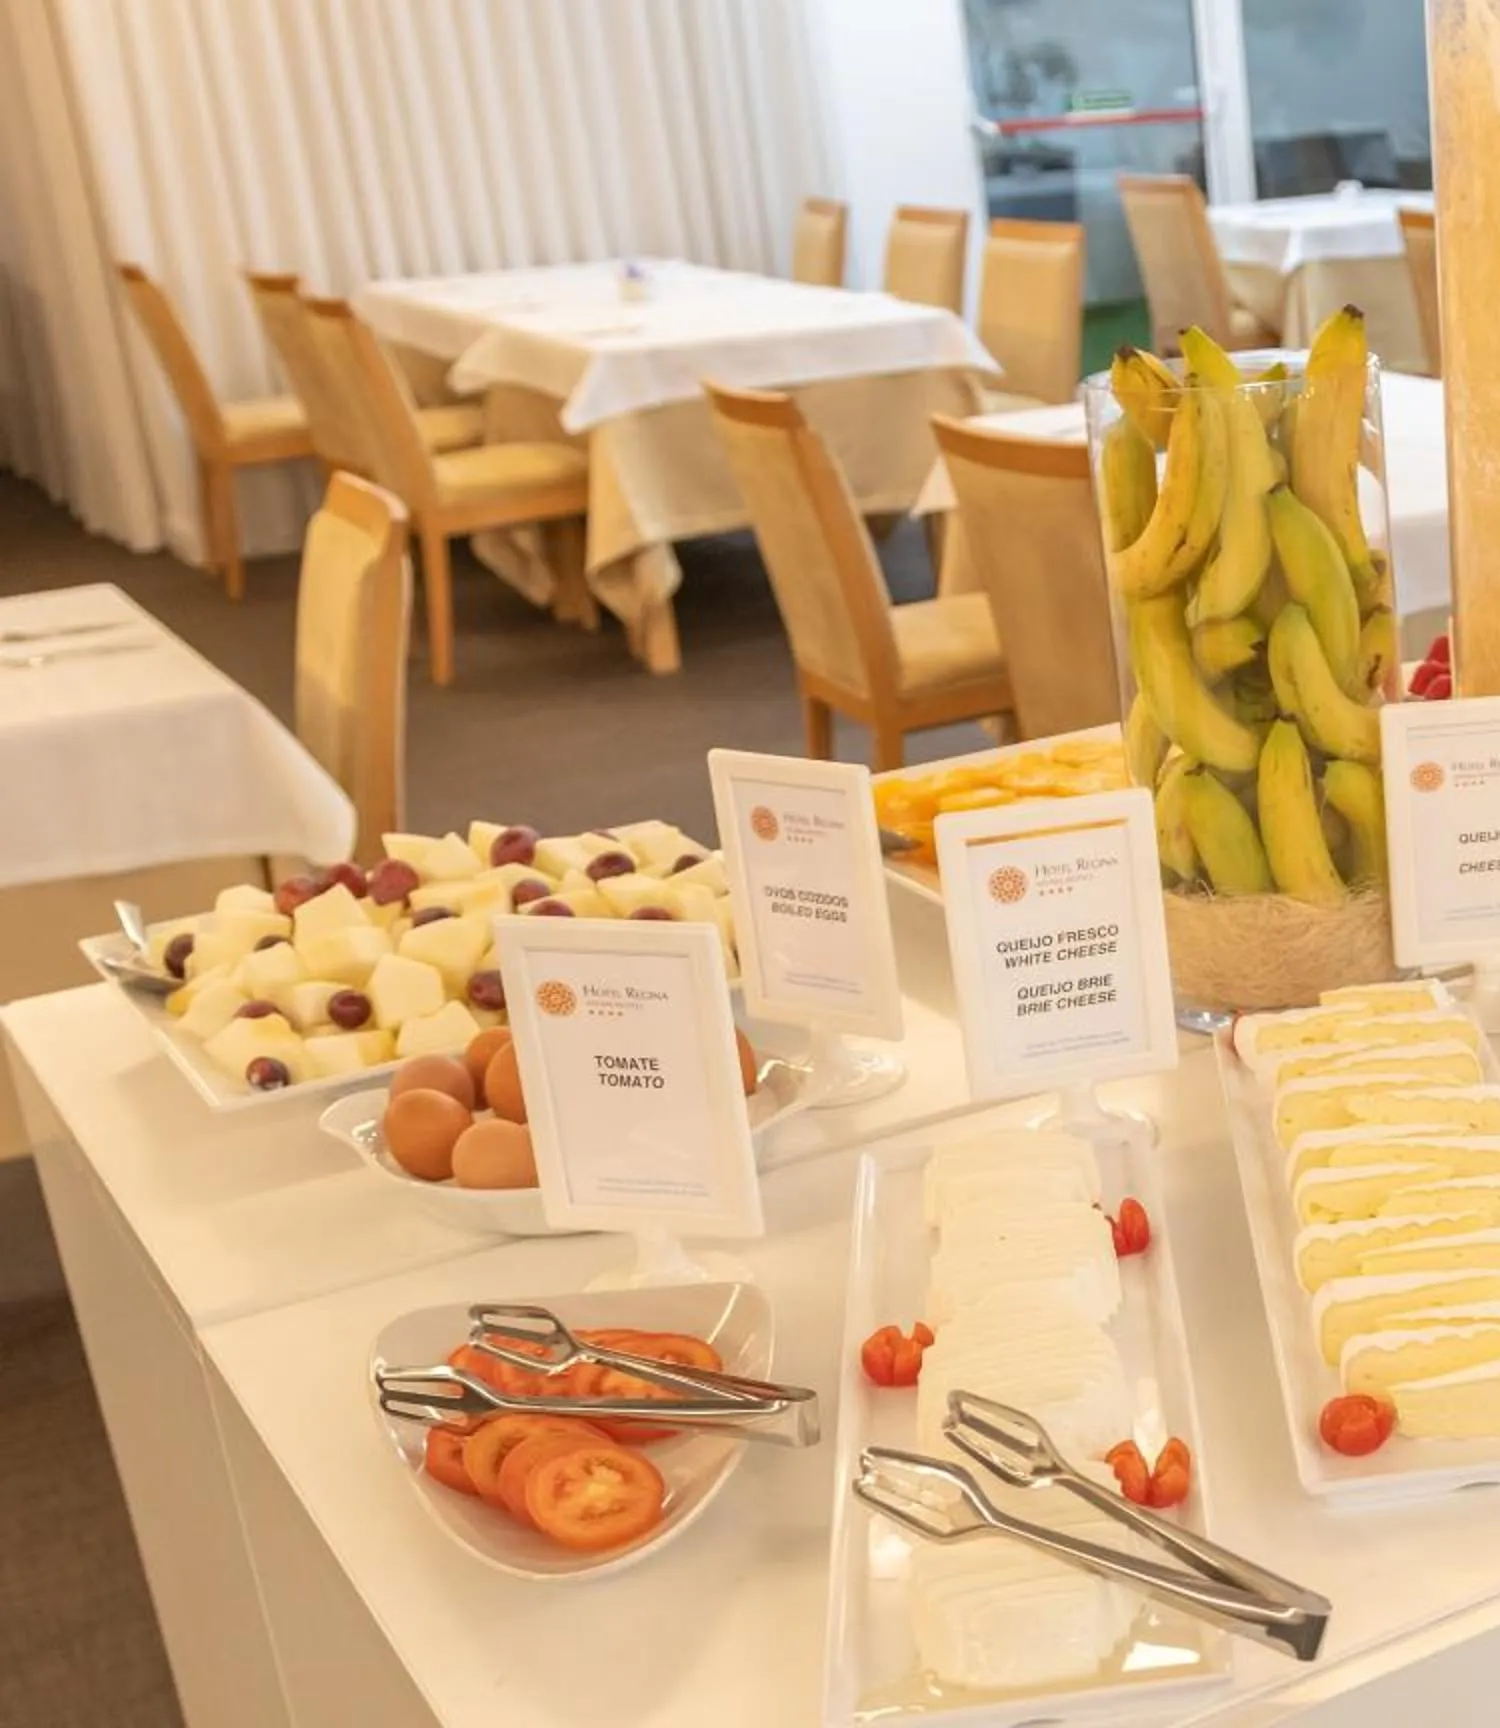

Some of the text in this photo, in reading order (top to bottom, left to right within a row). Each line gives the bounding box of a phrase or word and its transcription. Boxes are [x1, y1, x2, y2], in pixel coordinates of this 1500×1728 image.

[771, 901, 847, 922] BOILED EGGS
[996, 924, 1119, 954] QUEIJO FRESCO
[1005, 941, 1117, 969] WHITE CHEESE
[1017, 973, 1114, 1000] QUEIJO BRIE
[1017, 989, 1117, 1017] BRIE CHEESE
[594, 1055, 660, 1071] TOMATE
[598, 1073, 665, 1089] TOMATO
